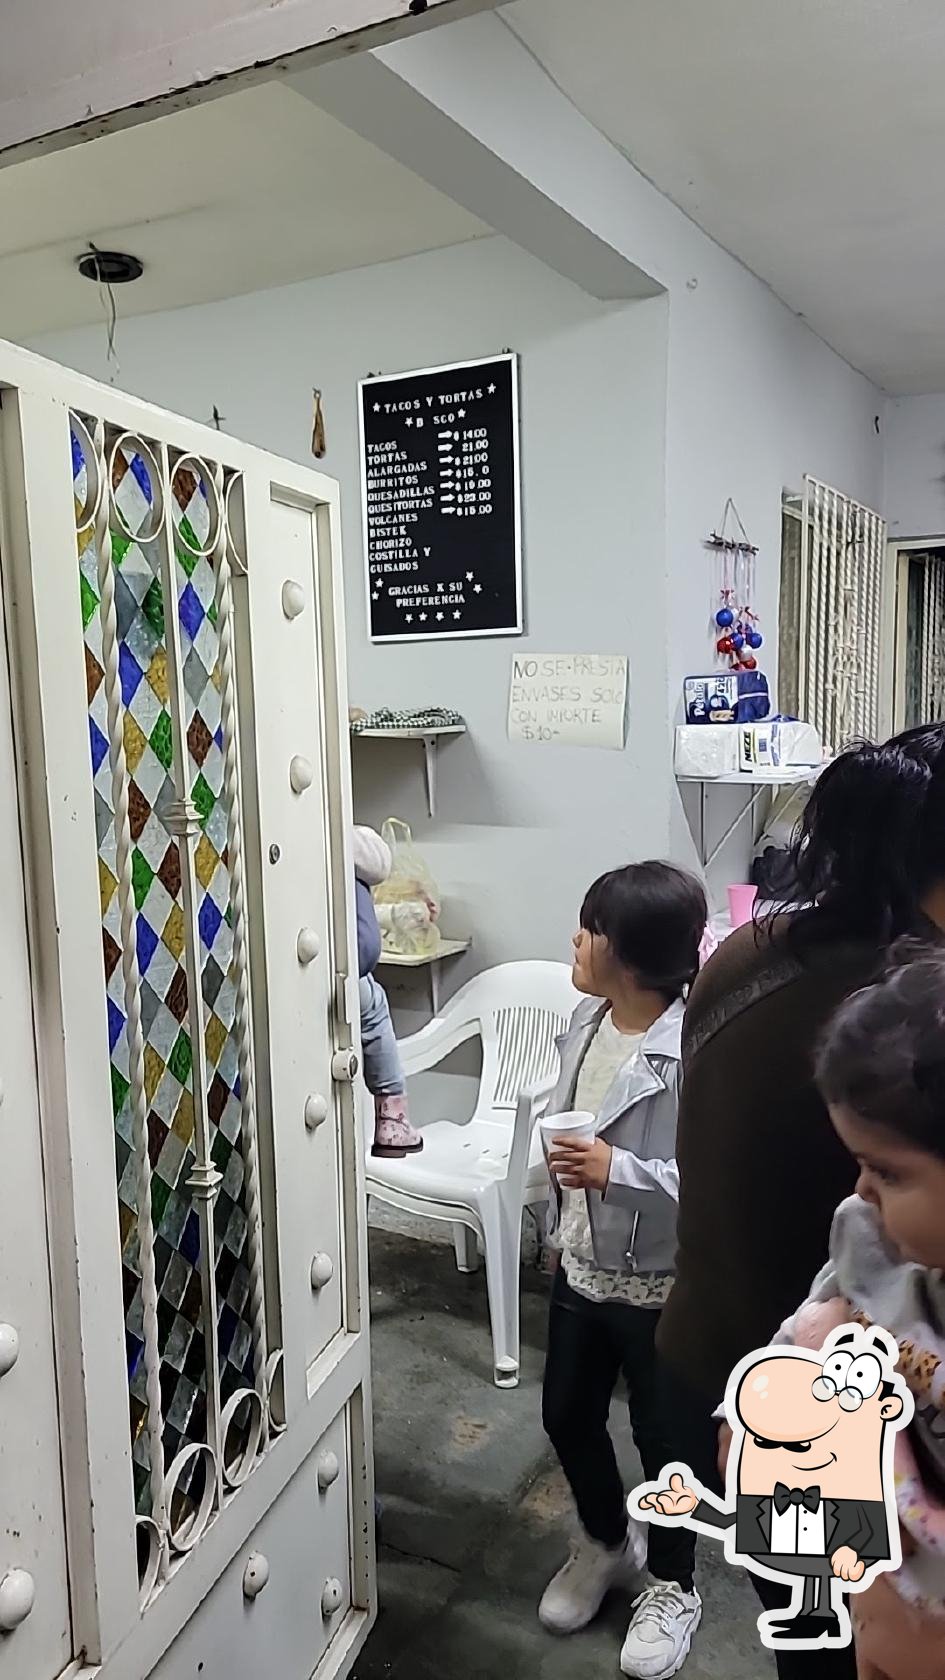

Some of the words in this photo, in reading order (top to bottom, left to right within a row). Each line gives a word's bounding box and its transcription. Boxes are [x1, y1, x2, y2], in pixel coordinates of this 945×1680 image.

[384, 399, 420, 413] TACOS
[426, 396, 433, 407] Y
[438, 388, 483, 405] TORTAS
[367, 440, 397, 453] TACOS
[367, 451, 407, 465] TORTAS
[367, 461, 427, 478] ALARGADAS
[367, 475, 418, 490] BURRITOS
[367, 486, 435, 501] QUESADILLAS
[369, 513, 418, 526] VOLCANES
[369, 525, 407, 538] BISTEK
[369, 537, 412, 550] CHORIZO
[369, 549, 418, 561] COSTILLA
[423, 547, 431, 557] Y
[370, 561, 418, 573] GUISADOS
[388, 584, 429, 596] GRACIAS
[436, 583, 444, 592] X
[449, 582, 463, 592] SU
[395, 594, 465, 608] PREFERENCIA
[513, 660, 537, 679] NO
[512, 685, 581, 702] ENVASES
[511, 708, 537, 723] CON
